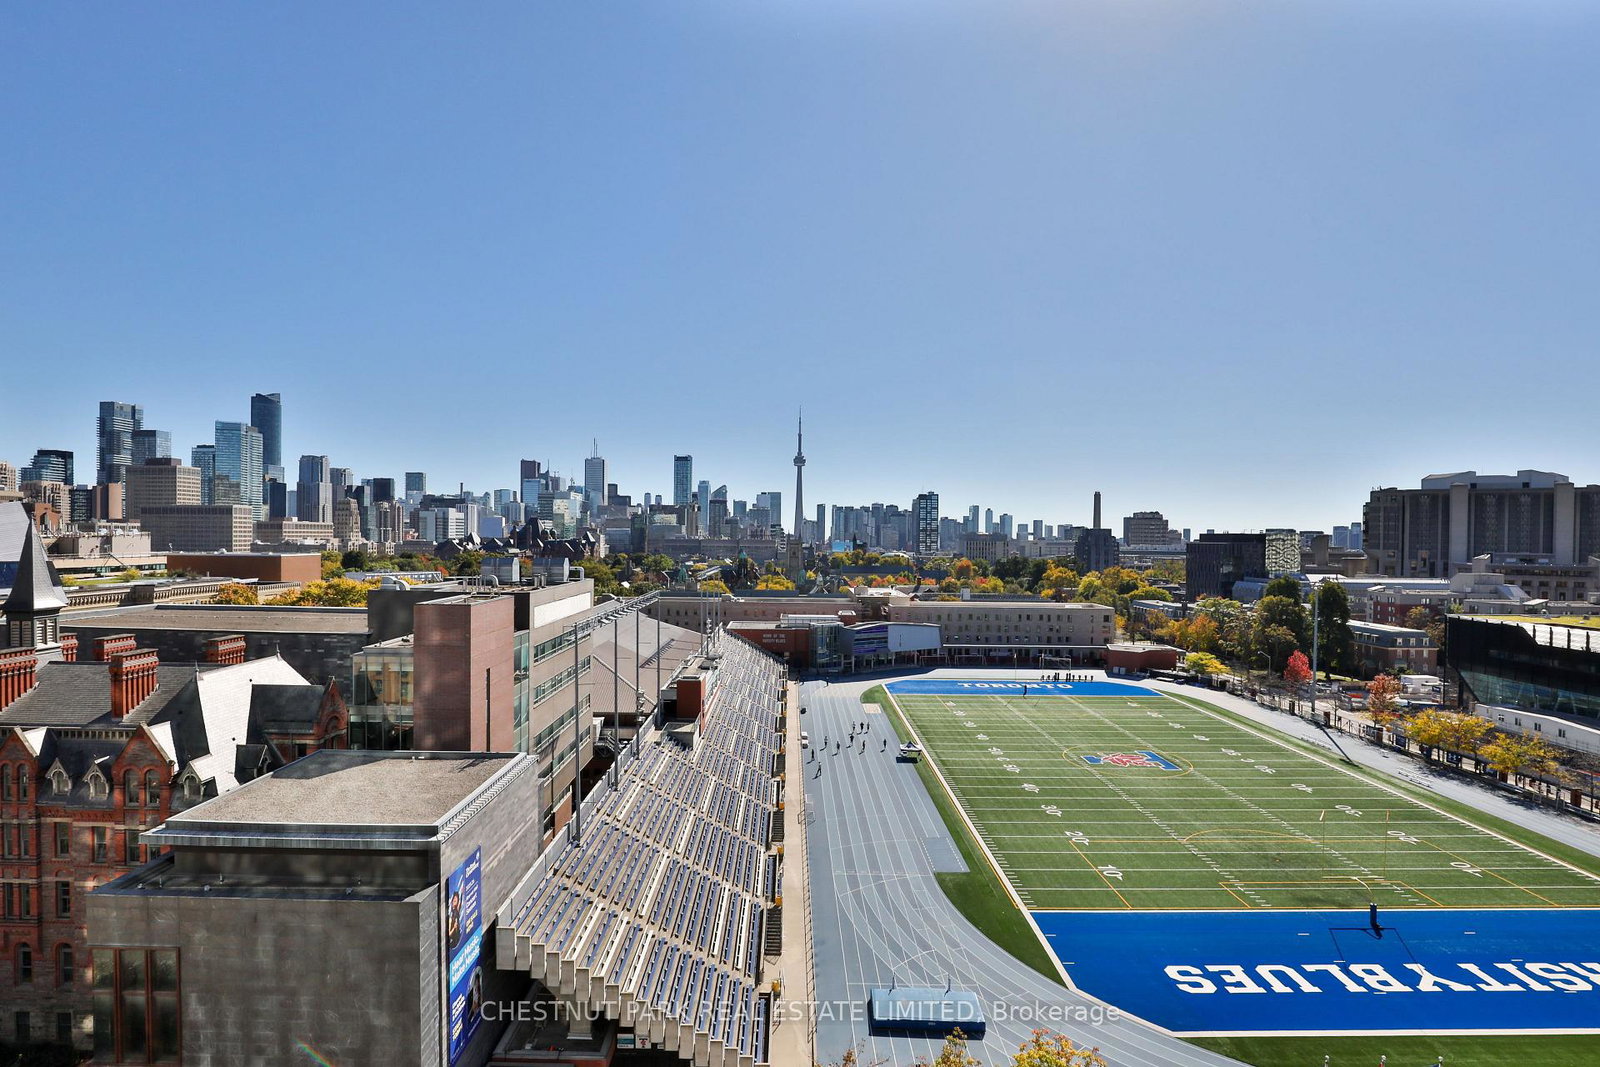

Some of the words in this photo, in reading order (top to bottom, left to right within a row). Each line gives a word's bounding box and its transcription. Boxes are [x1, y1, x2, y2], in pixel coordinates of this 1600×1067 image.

[1064, 831, 1090, 843] 20
[1098, 864, 1123, 877] 10
[1450, 861, 1482, 873] 10
[1163, 963, 1415, 994] BLUES
